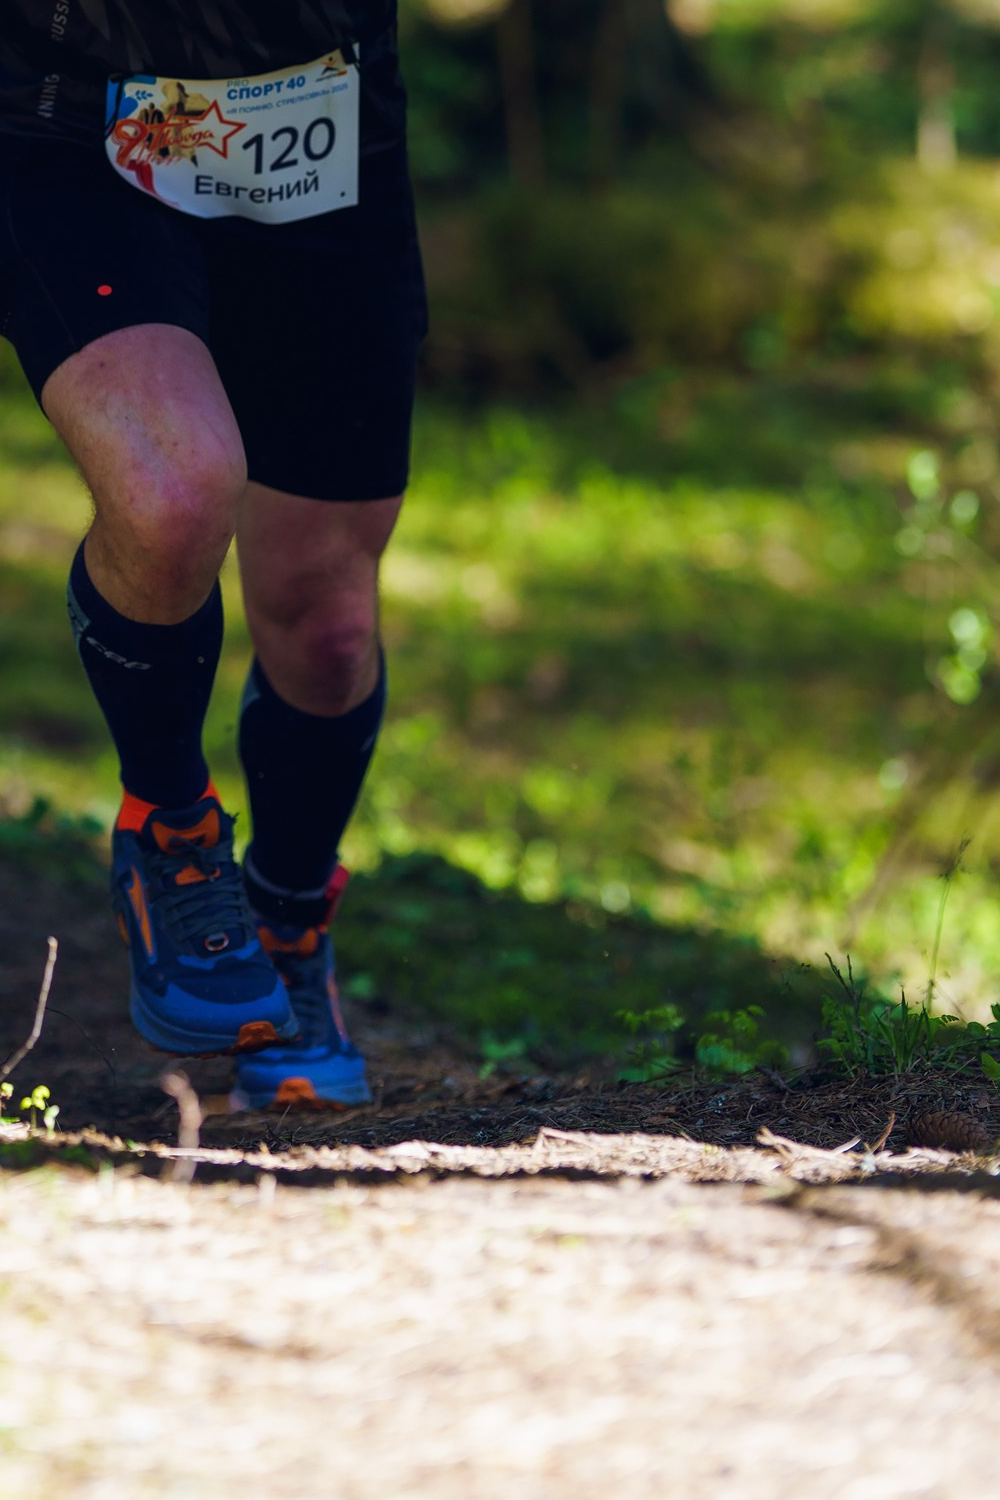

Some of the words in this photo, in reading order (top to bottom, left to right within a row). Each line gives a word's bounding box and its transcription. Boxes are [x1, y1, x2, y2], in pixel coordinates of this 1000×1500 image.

[226, 80, 285, 101] СПОРТ
[286, 75, 306, 91] 40
[241, 116, 337, 175] 120
[193, 169, 320, 204] Евгений
